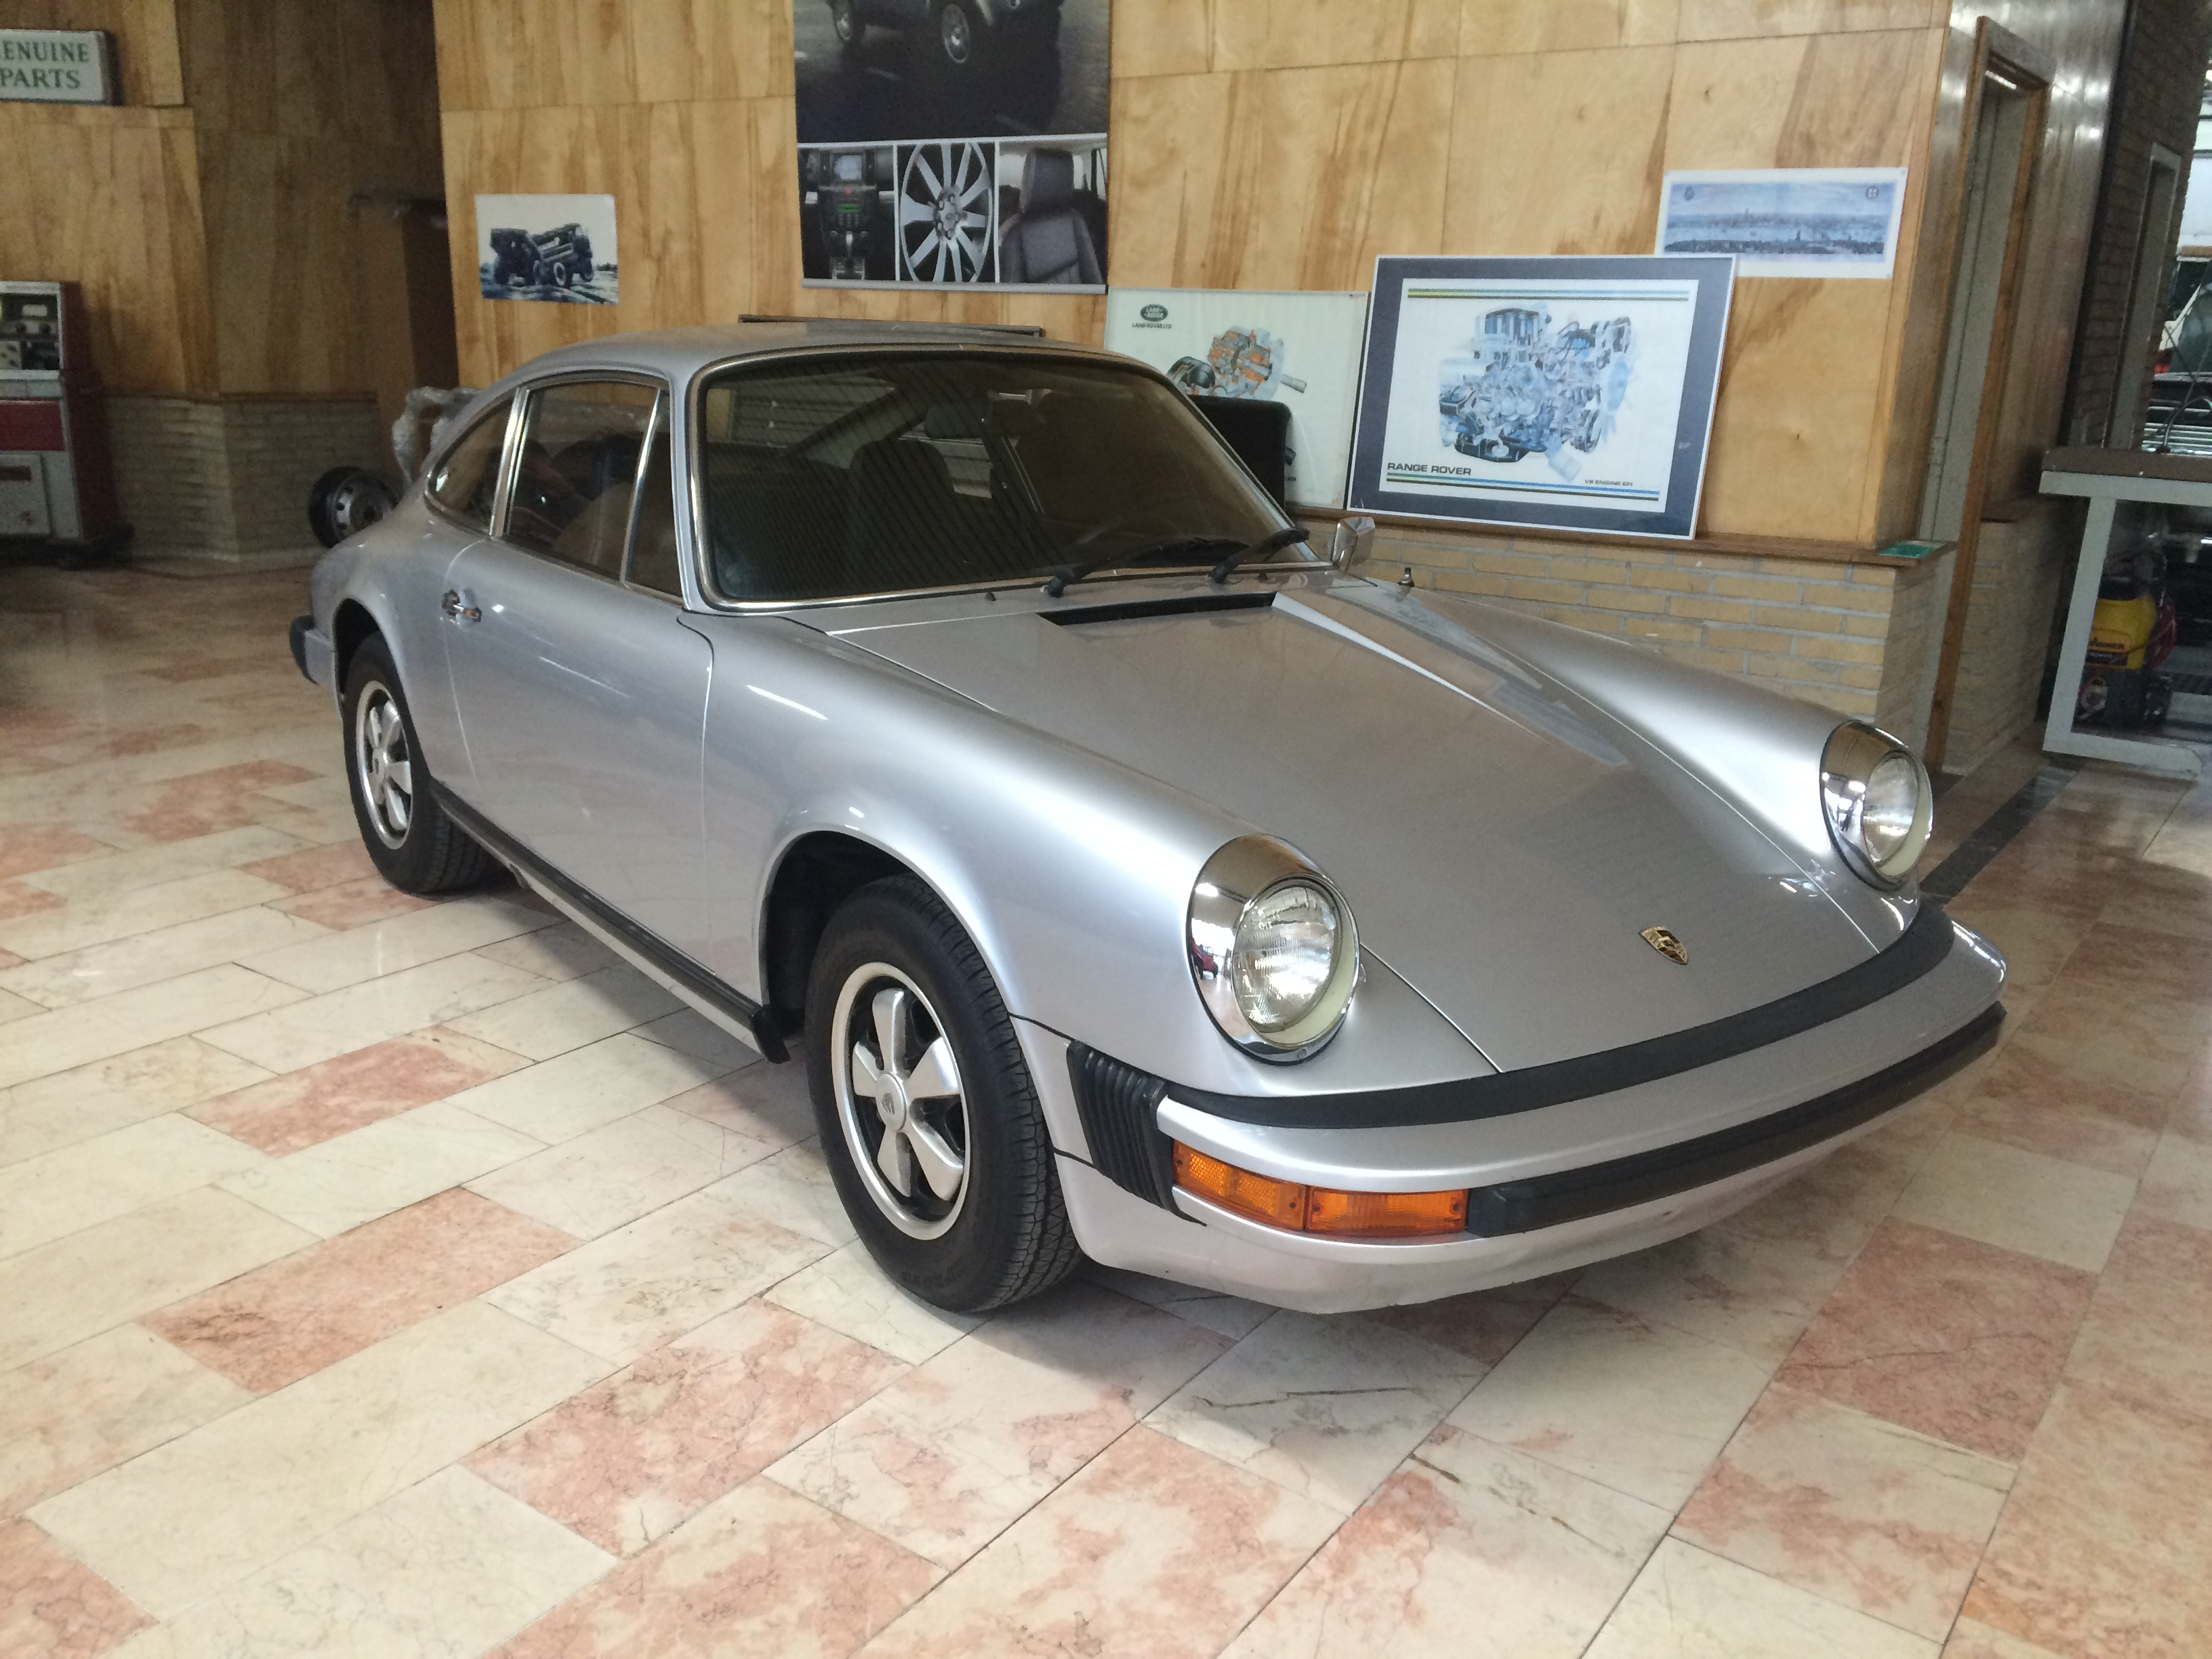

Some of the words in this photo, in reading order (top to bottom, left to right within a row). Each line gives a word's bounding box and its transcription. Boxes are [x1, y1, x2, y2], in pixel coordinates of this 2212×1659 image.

[0, 41, 89, 62] ENUINE
[0, 68, 81, 88] PARTS
[1387, 462, 1428, 472] RANGE
[1431, 465, 1471, 475] ROVER
